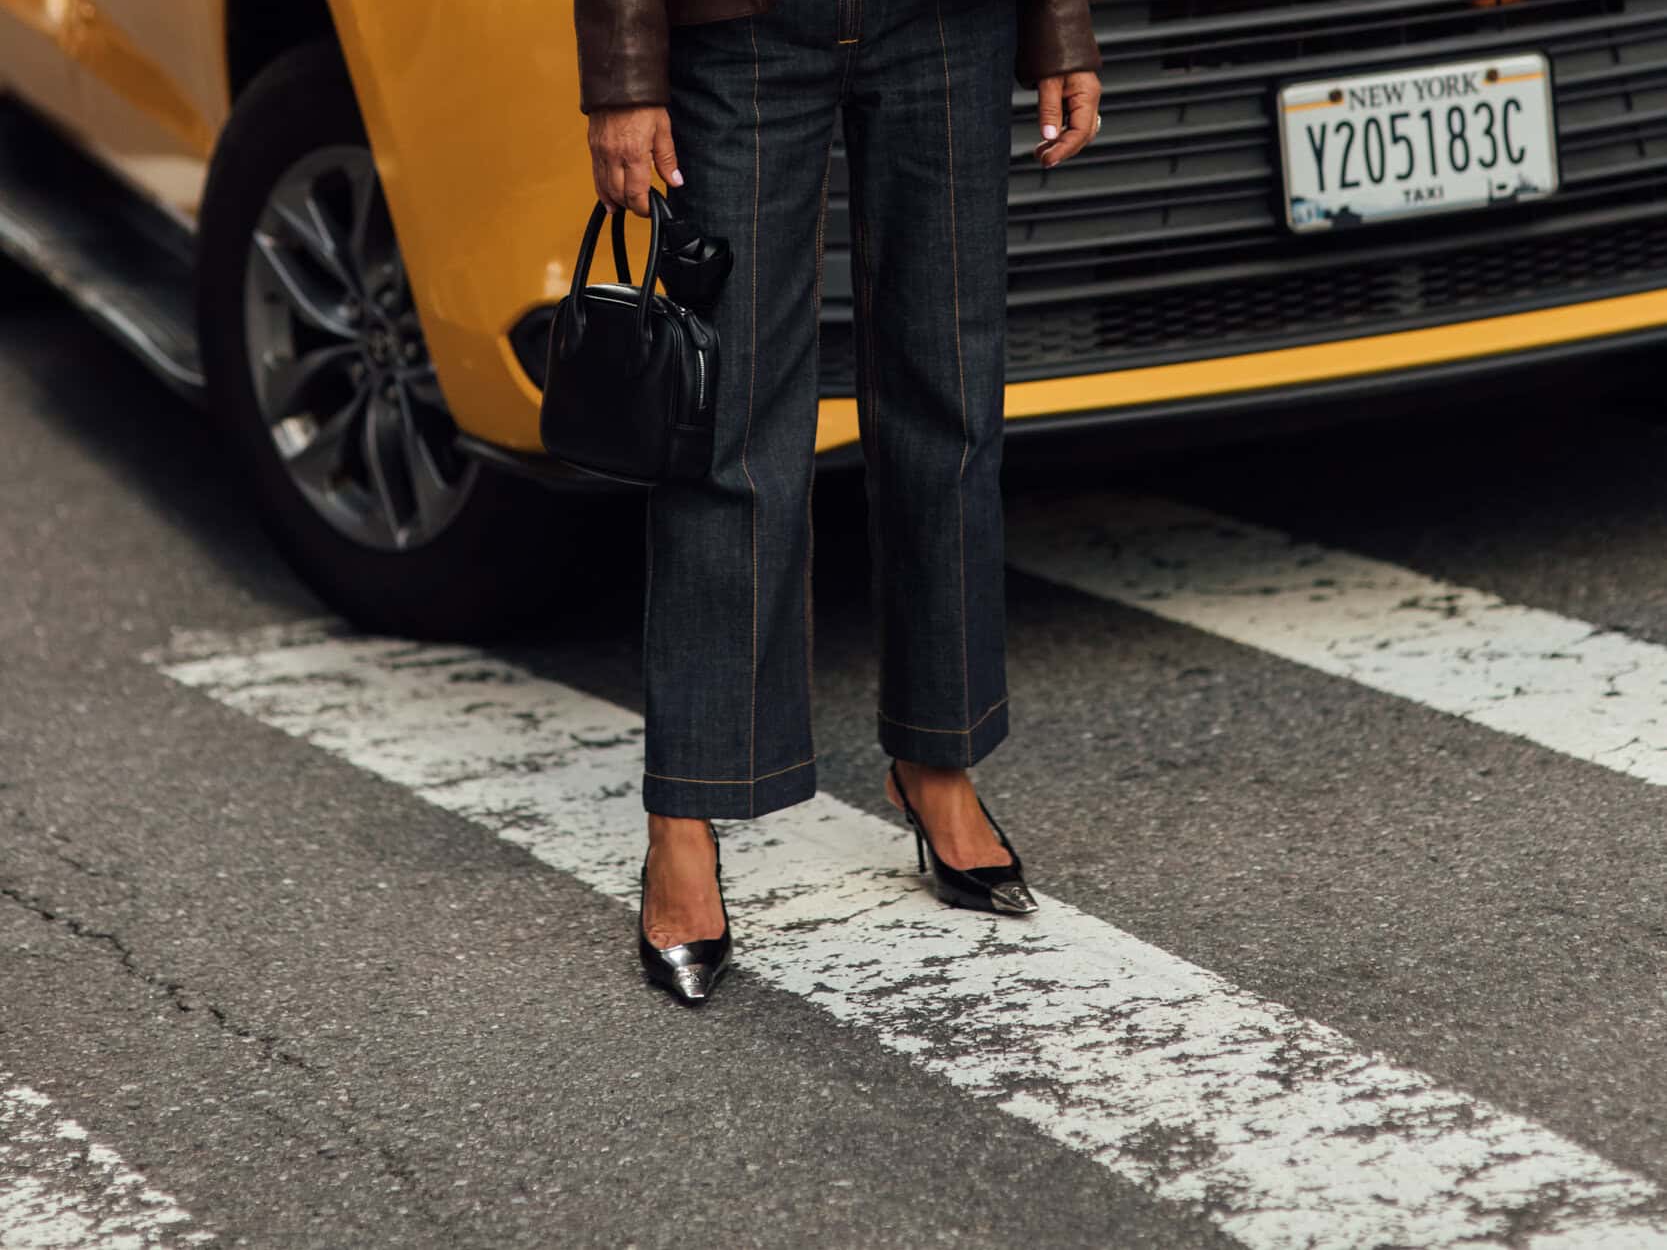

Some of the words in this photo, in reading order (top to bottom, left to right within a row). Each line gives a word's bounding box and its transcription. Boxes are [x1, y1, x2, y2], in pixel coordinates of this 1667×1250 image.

[1349, 79, 1406, 111] NEW
[1411, 70, 1479, 101] YORK
[1306, 97, 1525, 193] Y205183C
[1403, 185, 1444, 204] TAXI
